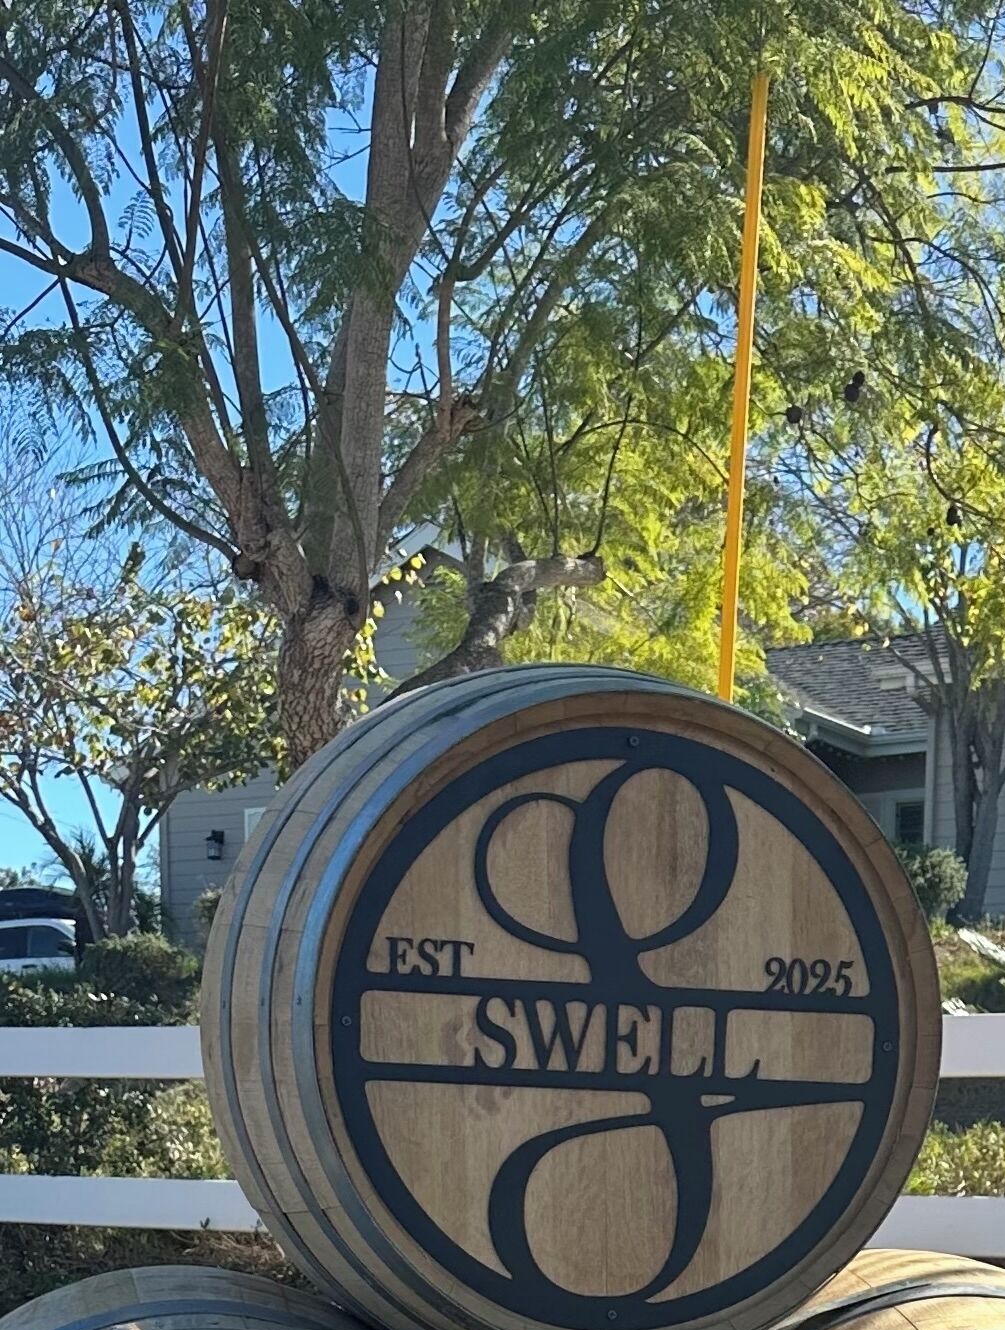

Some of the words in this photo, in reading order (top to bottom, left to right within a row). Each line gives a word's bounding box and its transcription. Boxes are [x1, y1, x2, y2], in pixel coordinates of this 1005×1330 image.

[385, 936, 475, 977] EST
[763, 956, 856, 997] 2025
[472, 996, 761, 1081] SWELL
